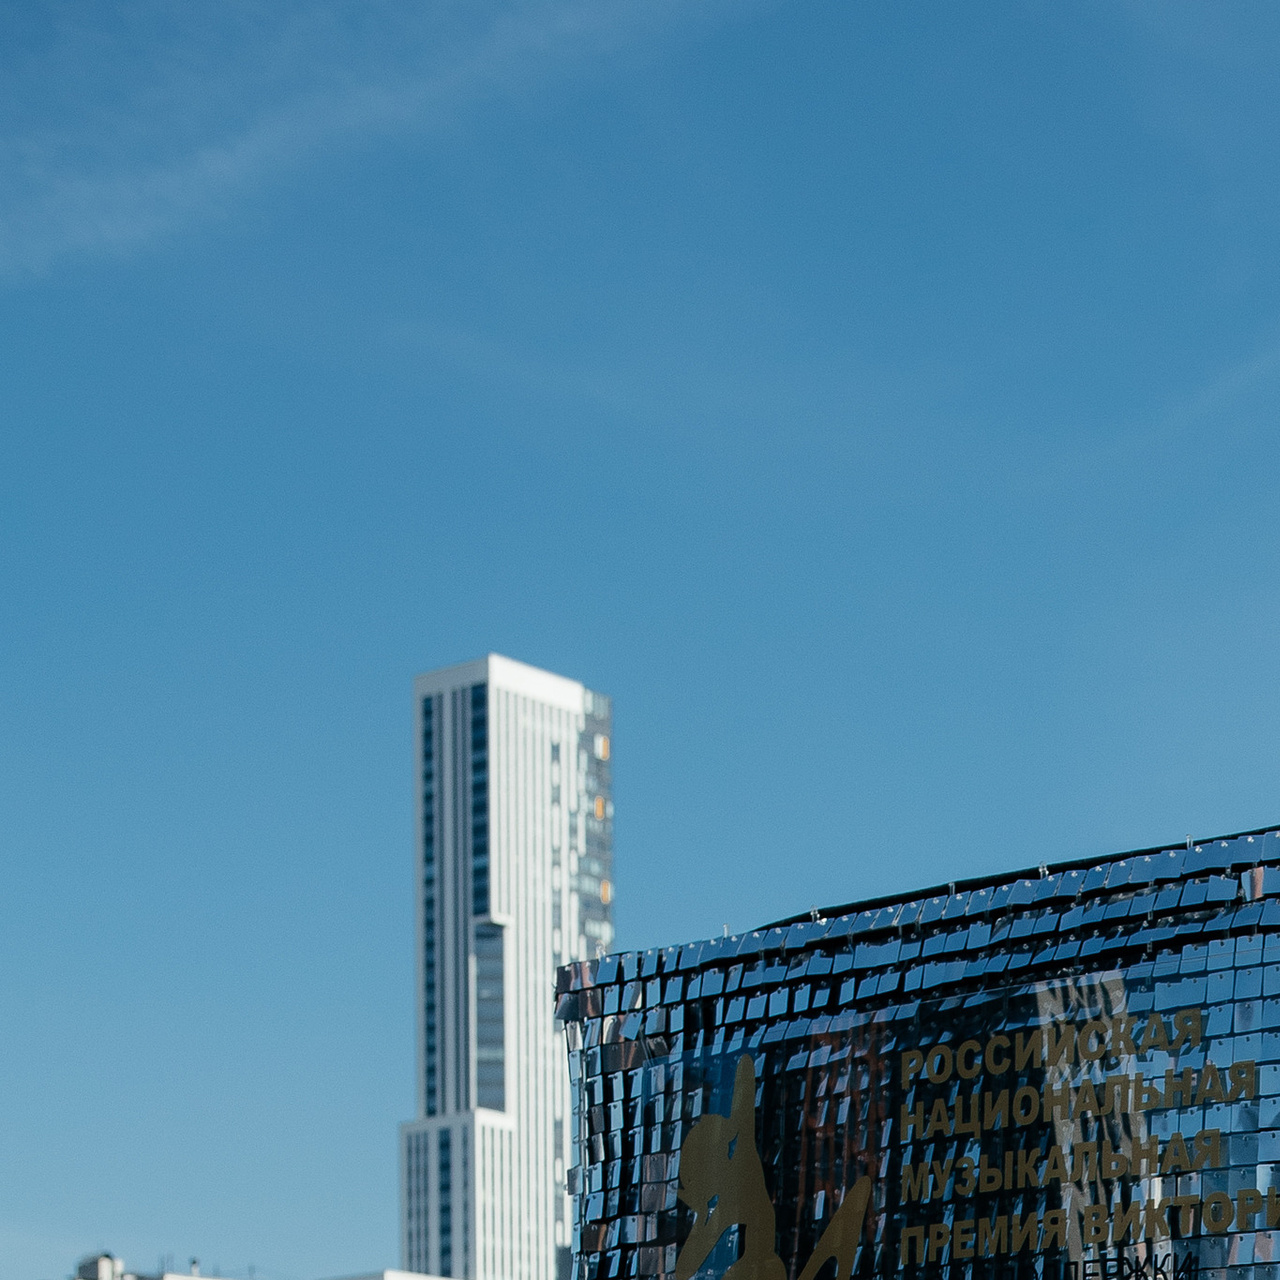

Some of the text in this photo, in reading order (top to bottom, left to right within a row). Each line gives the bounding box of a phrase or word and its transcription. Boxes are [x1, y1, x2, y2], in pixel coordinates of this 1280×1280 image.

[901, 1007, 1203, 1089] РОССИЙСКАЯ
[899, 1059, 1257, 1141] НАЦИОНАЛЬНАЯ
[901, 1128, 1222, 1204] МУЗЫКАЛЬНАЯ
[900, 1209, 1067, 1266] ПРЕМИЯ
